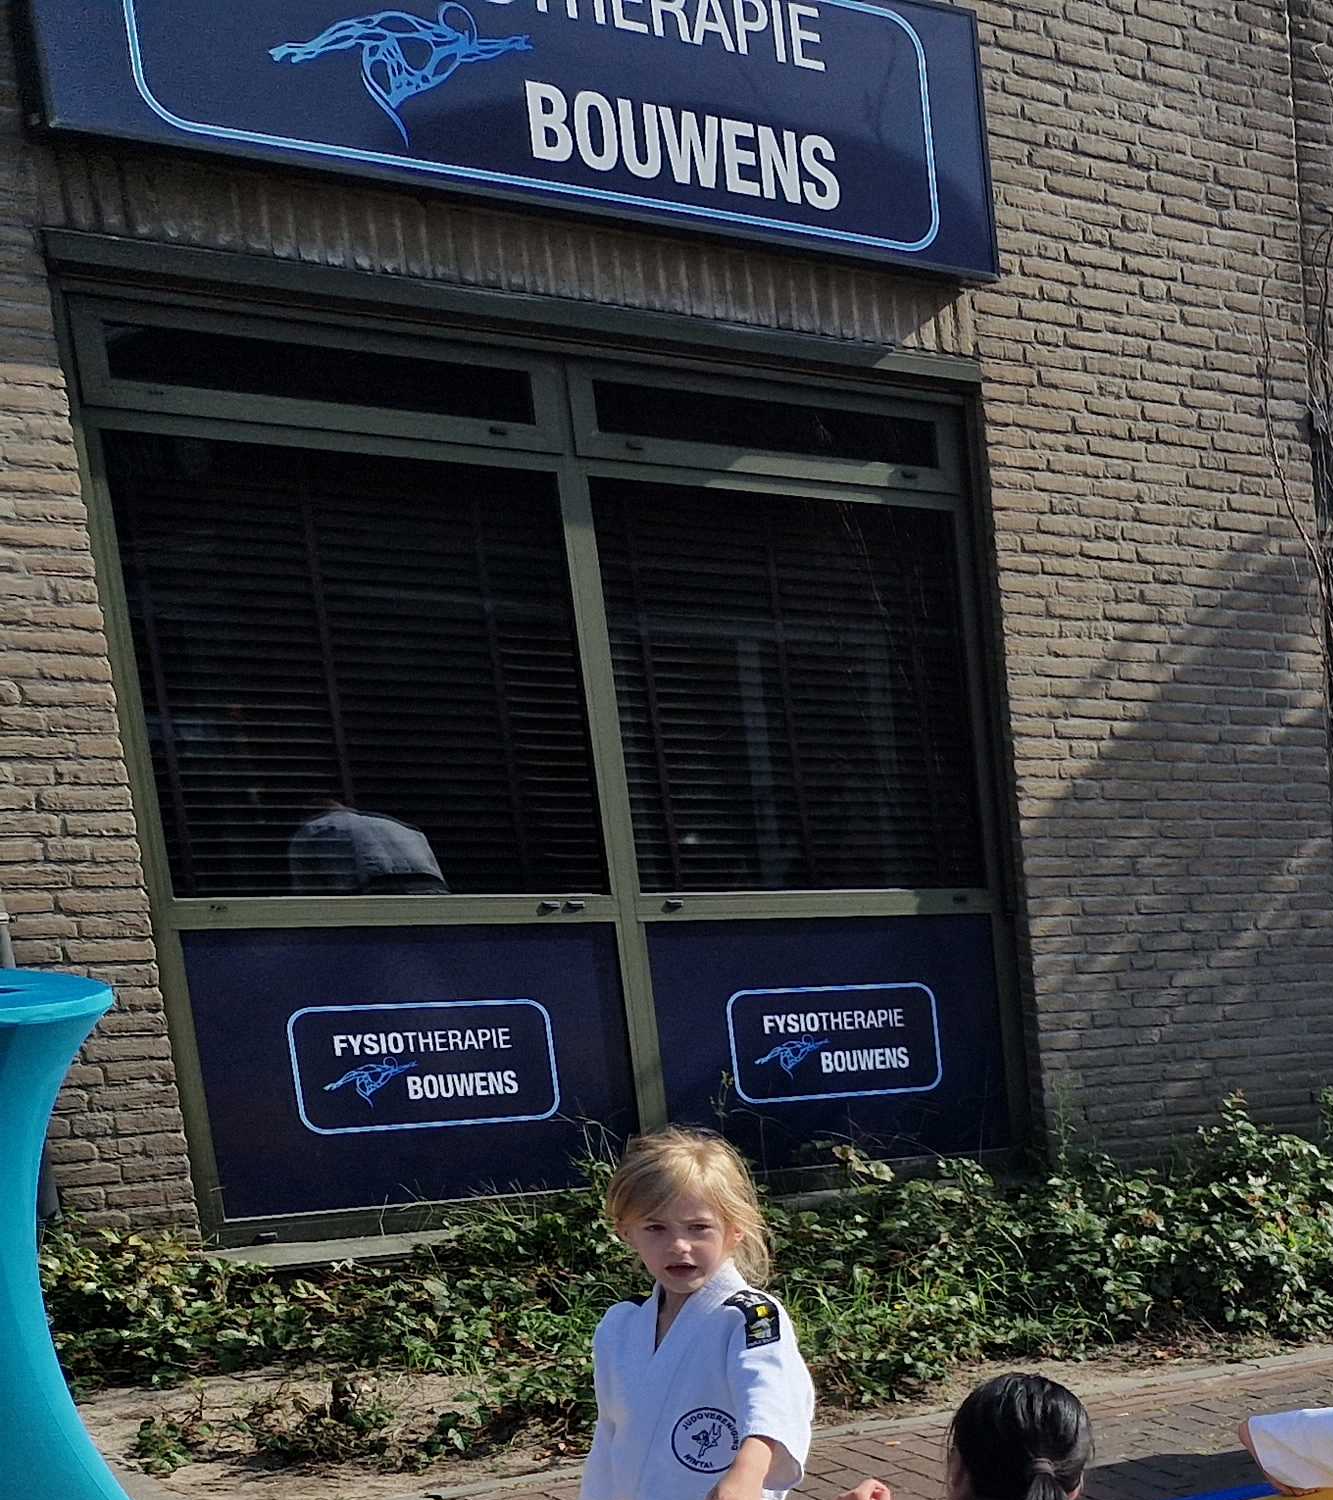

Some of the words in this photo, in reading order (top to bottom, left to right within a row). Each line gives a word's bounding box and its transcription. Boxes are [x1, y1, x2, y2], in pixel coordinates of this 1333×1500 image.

[524, 79, 840, 211] BOUWENS
[763, 1008, 905, 1034] FYSIOTHERAPIE
[333, 1027, 512, 1057] FYSIOTHERAPIE
[820, 1047, 910, 1073] BOUWENS
[406, 1070, 519, 1100] BOUWENS
[682, 1411, 739, 1451] JUDOVERENIGING
